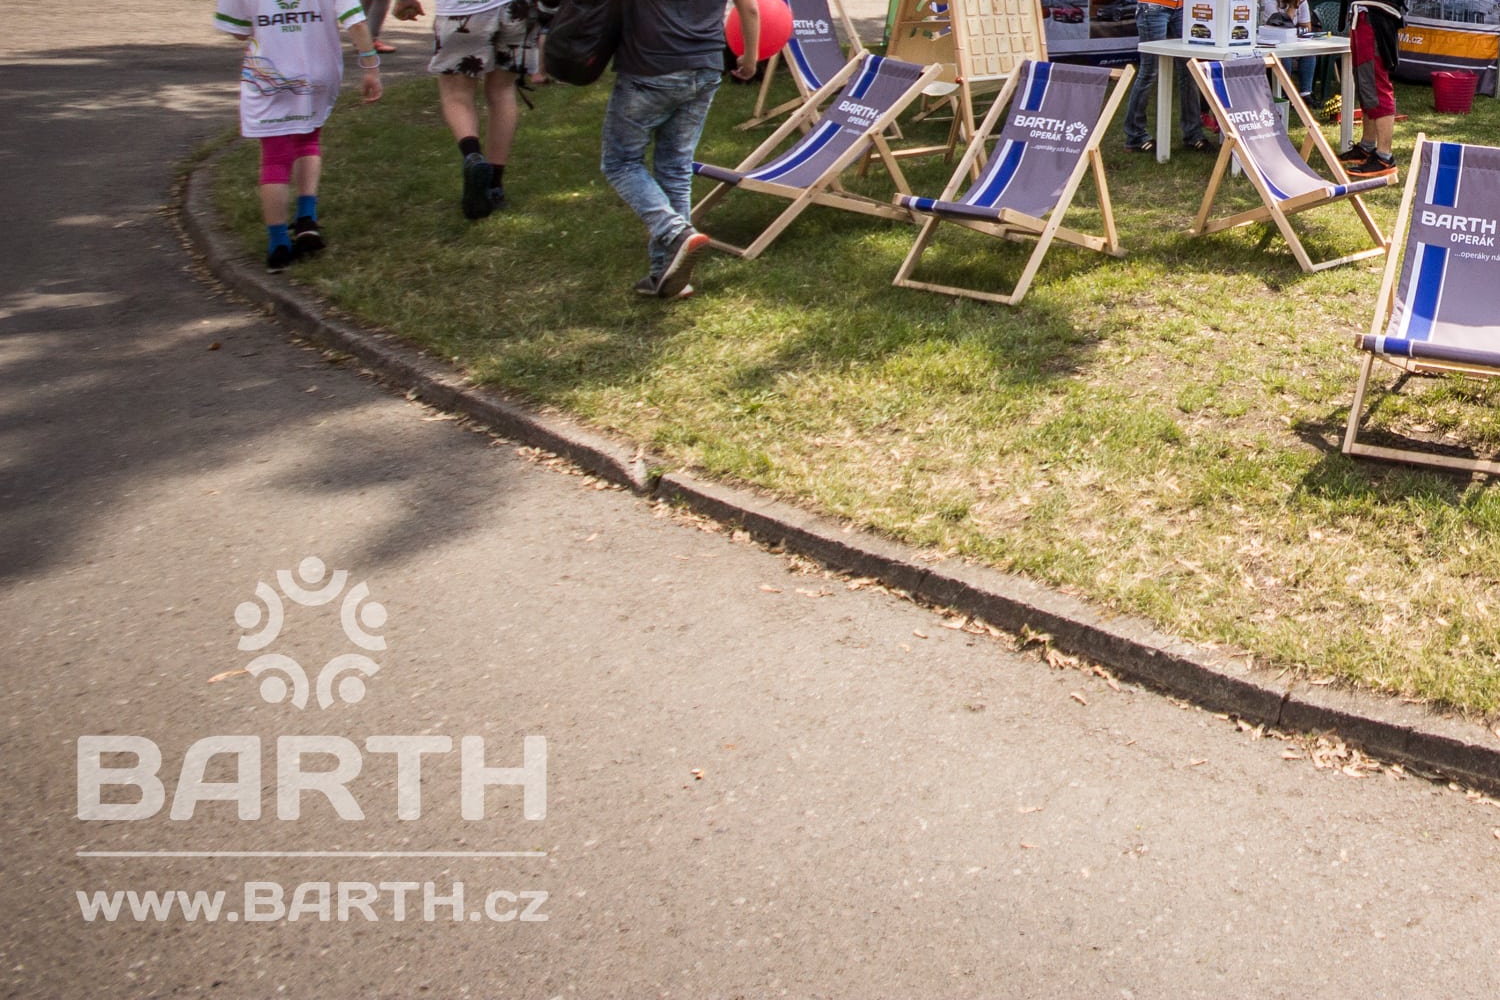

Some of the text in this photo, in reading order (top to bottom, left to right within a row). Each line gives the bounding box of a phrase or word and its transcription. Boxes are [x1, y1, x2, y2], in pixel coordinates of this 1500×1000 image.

[257, 11, 323, 27] BARTH
[792, 19, 814, 29] RTH
[281, 24, 302, 32] RUN
[838, 100, 879, 119] BARTH
[1013, 115, 1066, 131] BARTH
[1227, 110, 1259, 124] ARTH
[1030, 130, 1062, 141] OPERÁK
[1421, 210, 1497, 235] BARTH
[1450, 232, 1495, 247] OPERÁK
[1454, 250, 1490, 262] ...operáky
